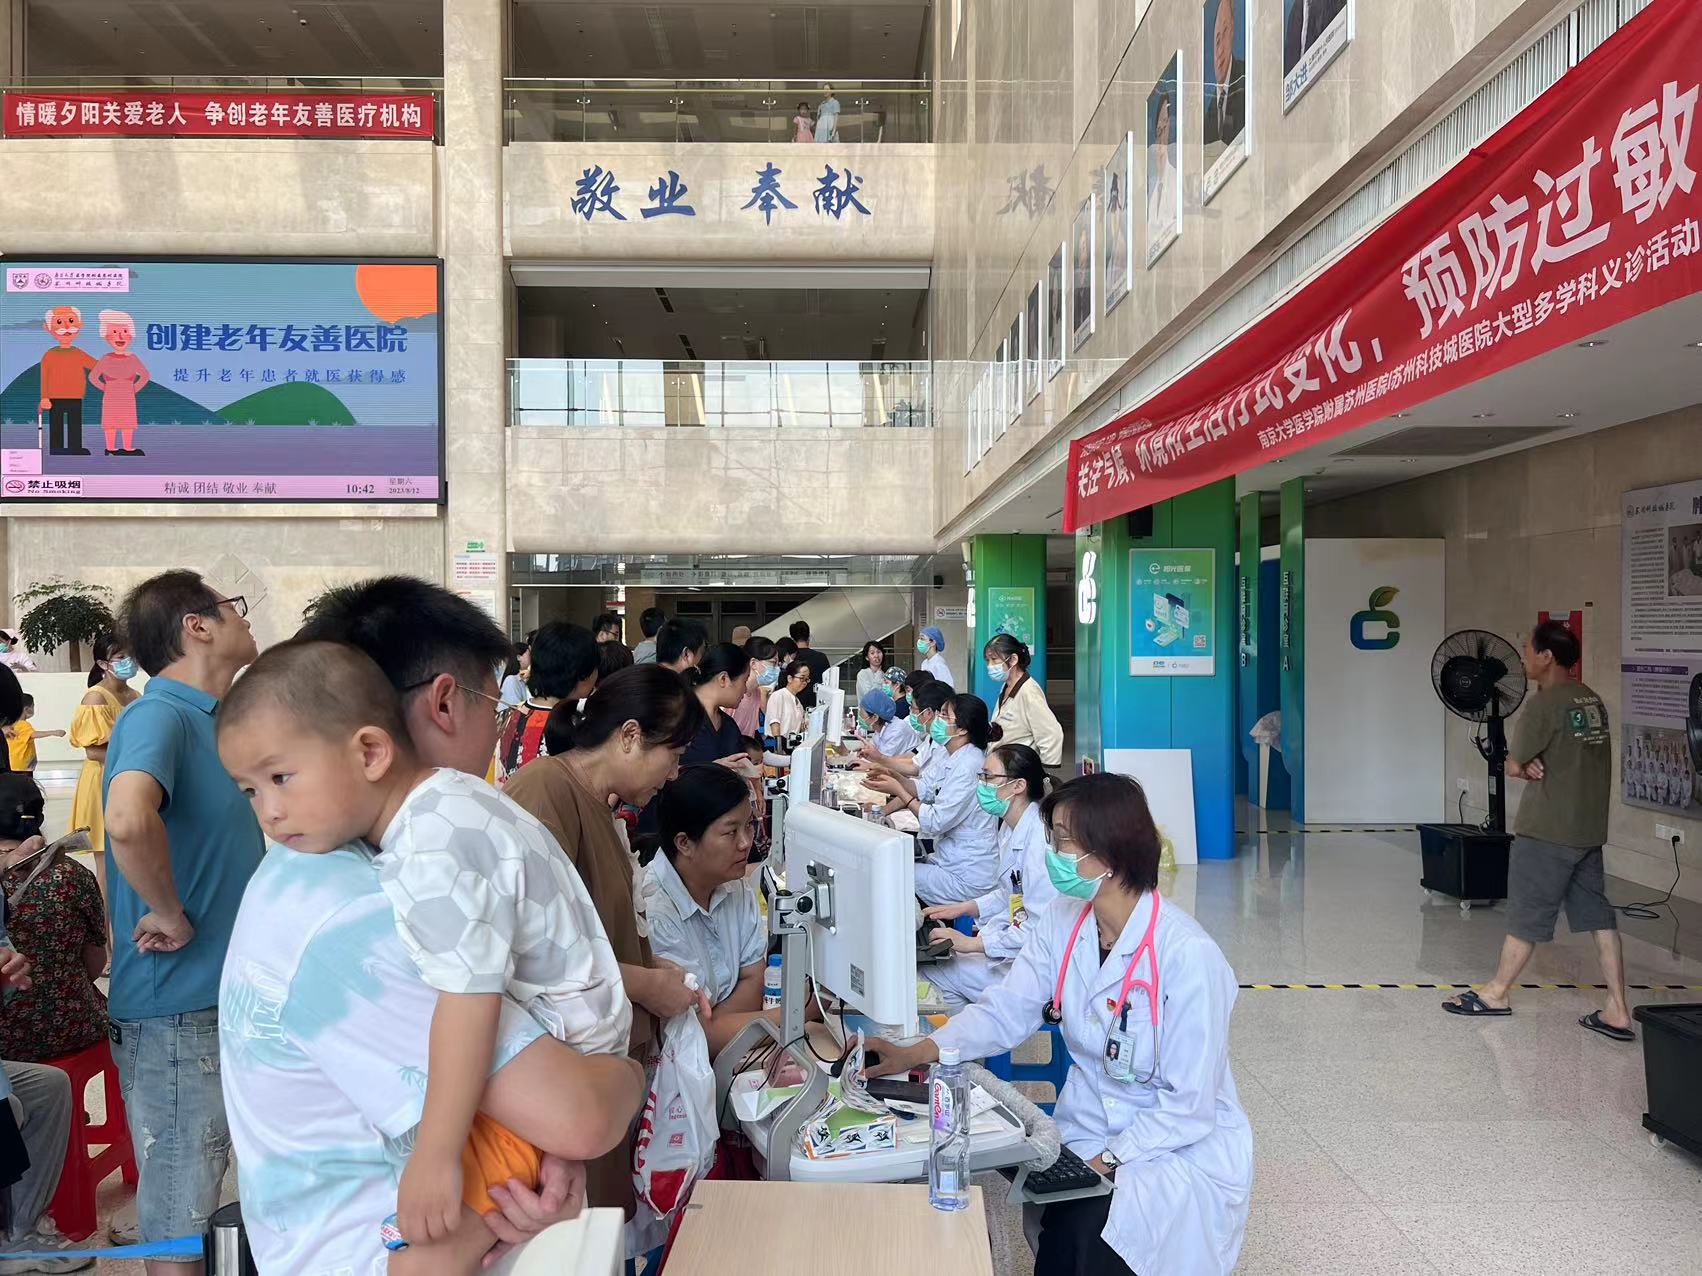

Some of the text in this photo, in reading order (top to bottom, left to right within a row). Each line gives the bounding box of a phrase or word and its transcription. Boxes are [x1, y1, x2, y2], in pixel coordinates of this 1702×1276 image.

[16, 101, 422, 128] 情暖夕阳关爱老人 争创老年友善医疗机构
[571, 162, 871, 226] 敬业 奉献
[146, 323, 408, 353] 创建老年友善医院
[174, 368, 408, 383] 提升老年患者就医获得感
[27, 480, 81, 489] 禁止吸烟
[164, 482, 277, 494] 精诚 团结 敬业 奉献
[346, 484, 375, 494] 10:42
